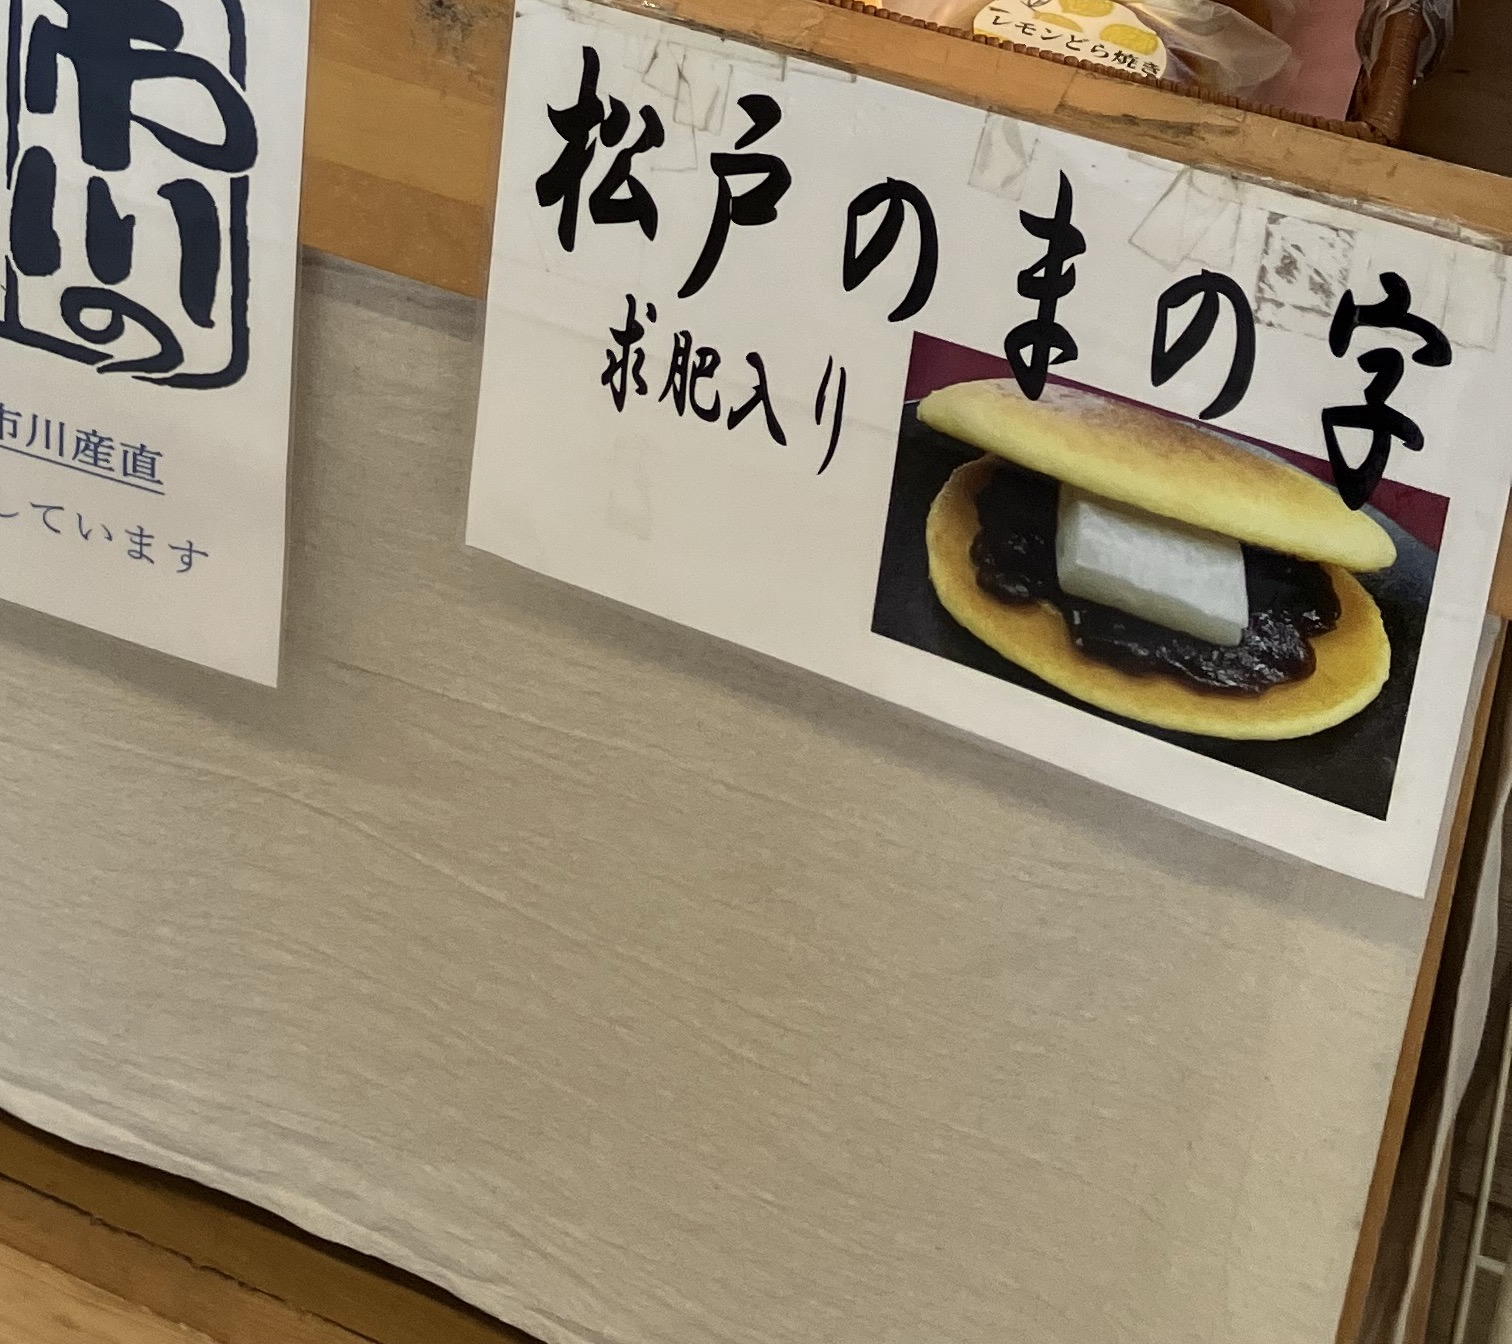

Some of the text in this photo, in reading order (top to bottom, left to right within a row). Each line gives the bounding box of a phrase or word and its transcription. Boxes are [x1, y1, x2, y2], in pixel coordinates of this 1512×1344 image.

[990, 14, 1161, 76] レモンどら焼き
[535, 45, 1453, 511] 松戸のまの字
[599, 292, 849, 476] 求肥入り
